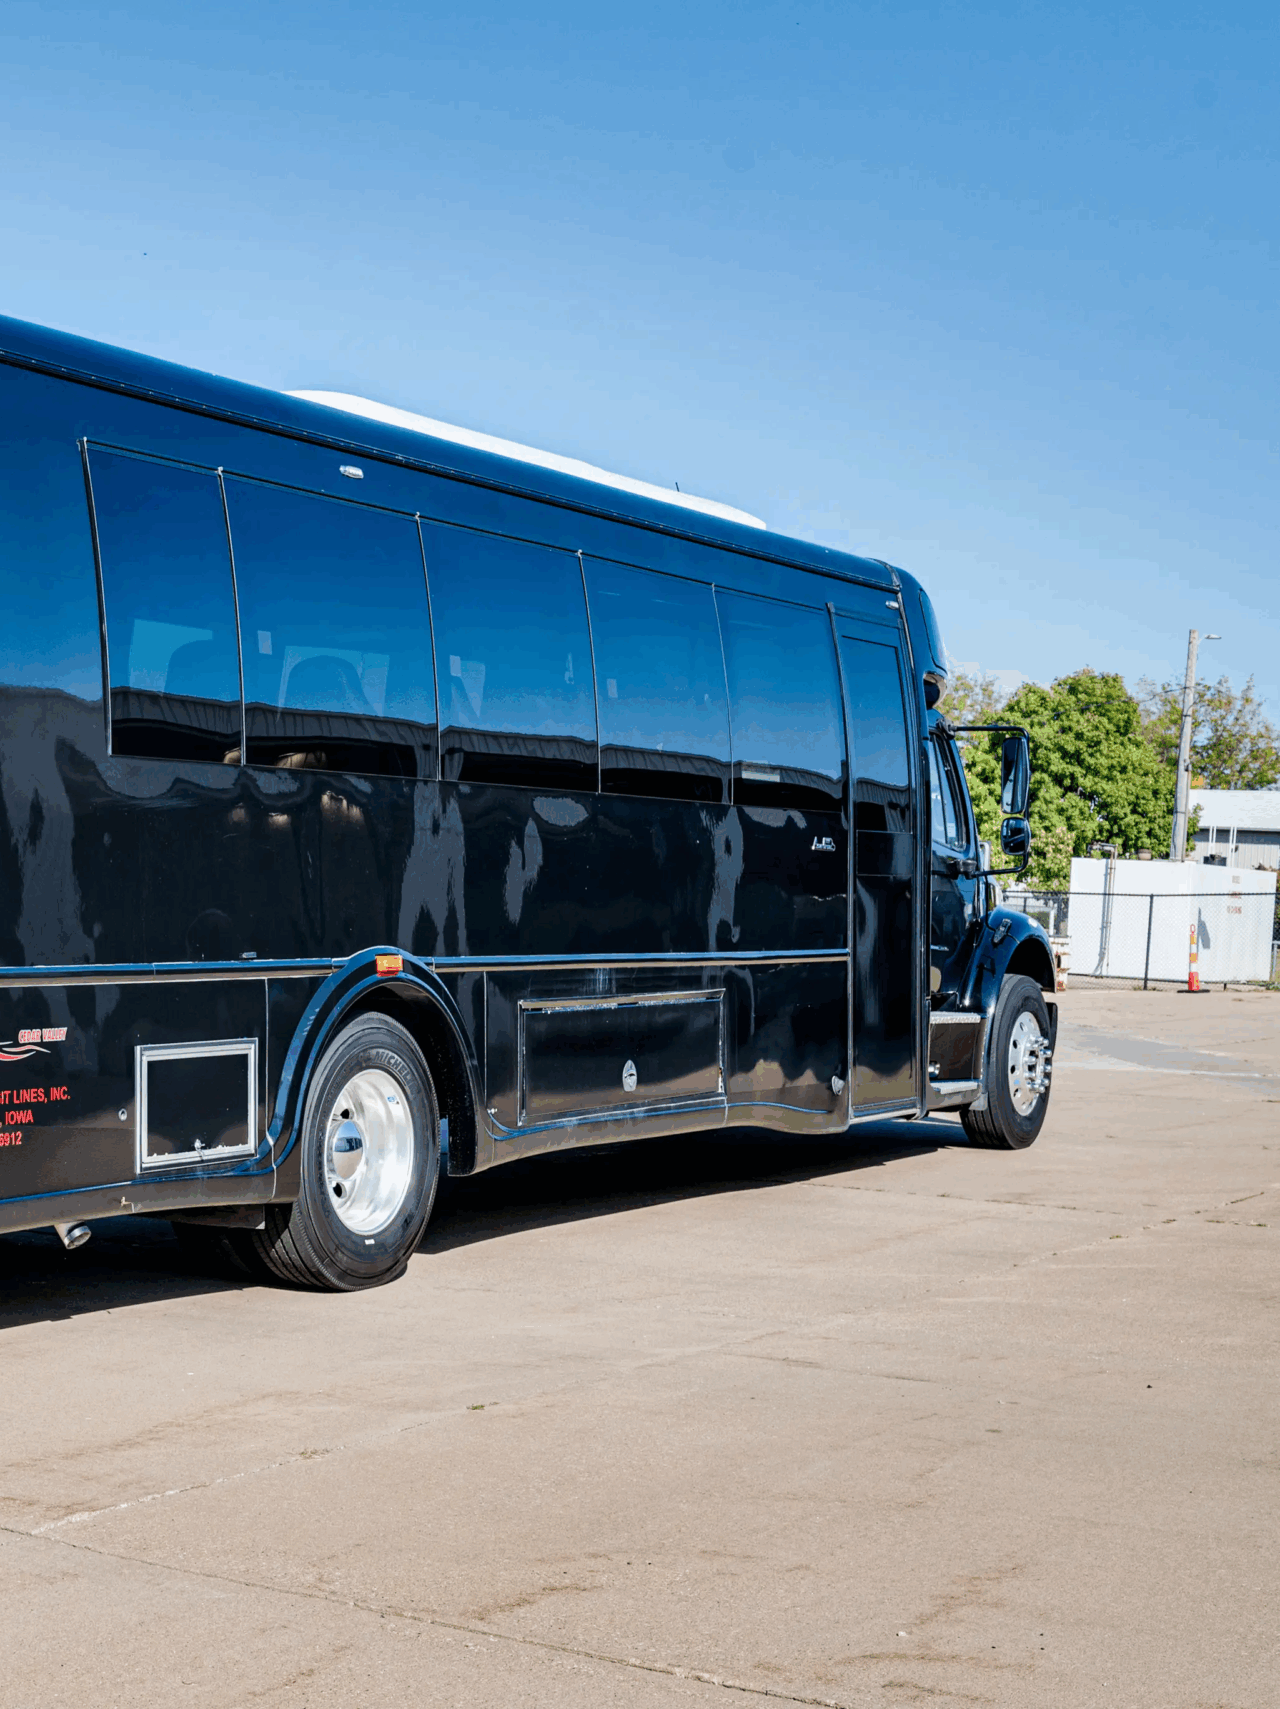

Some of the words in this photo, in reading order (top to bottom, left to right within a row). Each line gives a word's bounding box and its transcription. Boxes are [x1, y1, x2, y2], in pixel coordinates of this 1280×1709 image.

[18, 1029, 42, 1044] CEDAR
[42, 1027, 68, 1042] VALLEY
[13, 1087, 48, 1104] LINES,
[50, 1086, 71, 1101] INC.
[5, 1109, 34, 1126] IOWA
